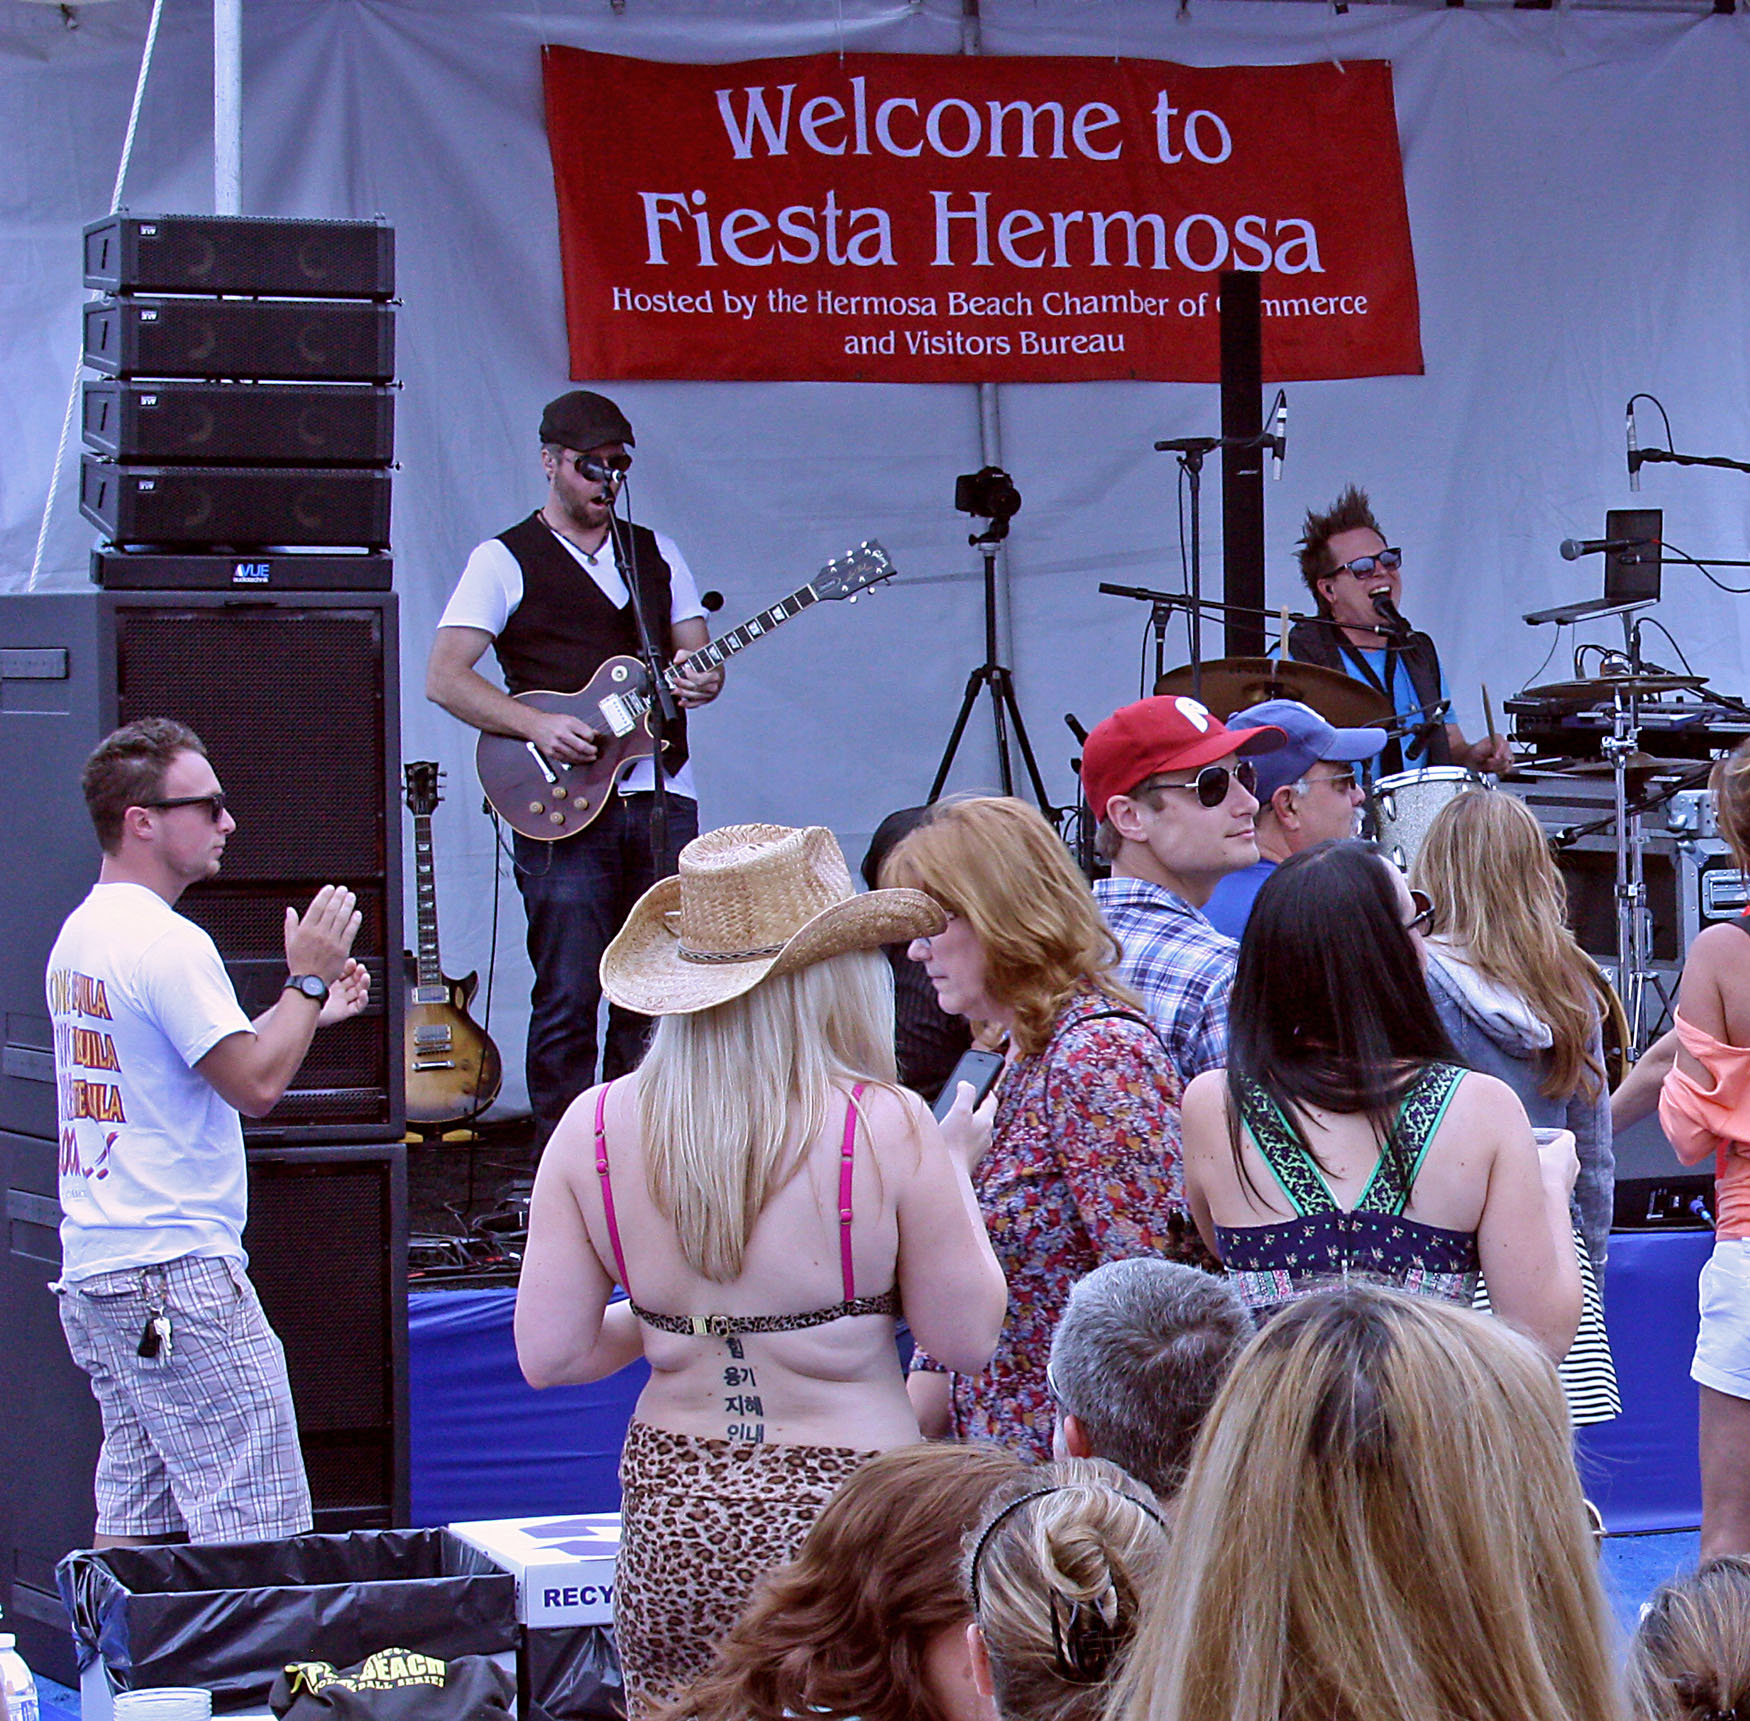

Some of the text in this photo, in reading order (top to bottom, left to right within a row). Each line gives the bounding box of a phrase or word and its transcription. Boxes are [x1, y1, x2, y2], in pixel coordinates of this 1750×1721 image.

[715, 76, 1234, 166] Welcome to
[637, 189, 1326, 275] Fiesta Hermosa
[612, 287, 1368, 320] Hosted by the Hermosa Beach Chamber of mmerce
[844, 330, 1125, 355] and Visitors Bureau
[236, 563, 270, 577] VUE
[723, 1366, 757, 1387] 용기
[724, 1394, 764, 1417] 지혜
[727, 1422, 764, 1443] 인내
[543, 1585, 614, 1608] RECY
